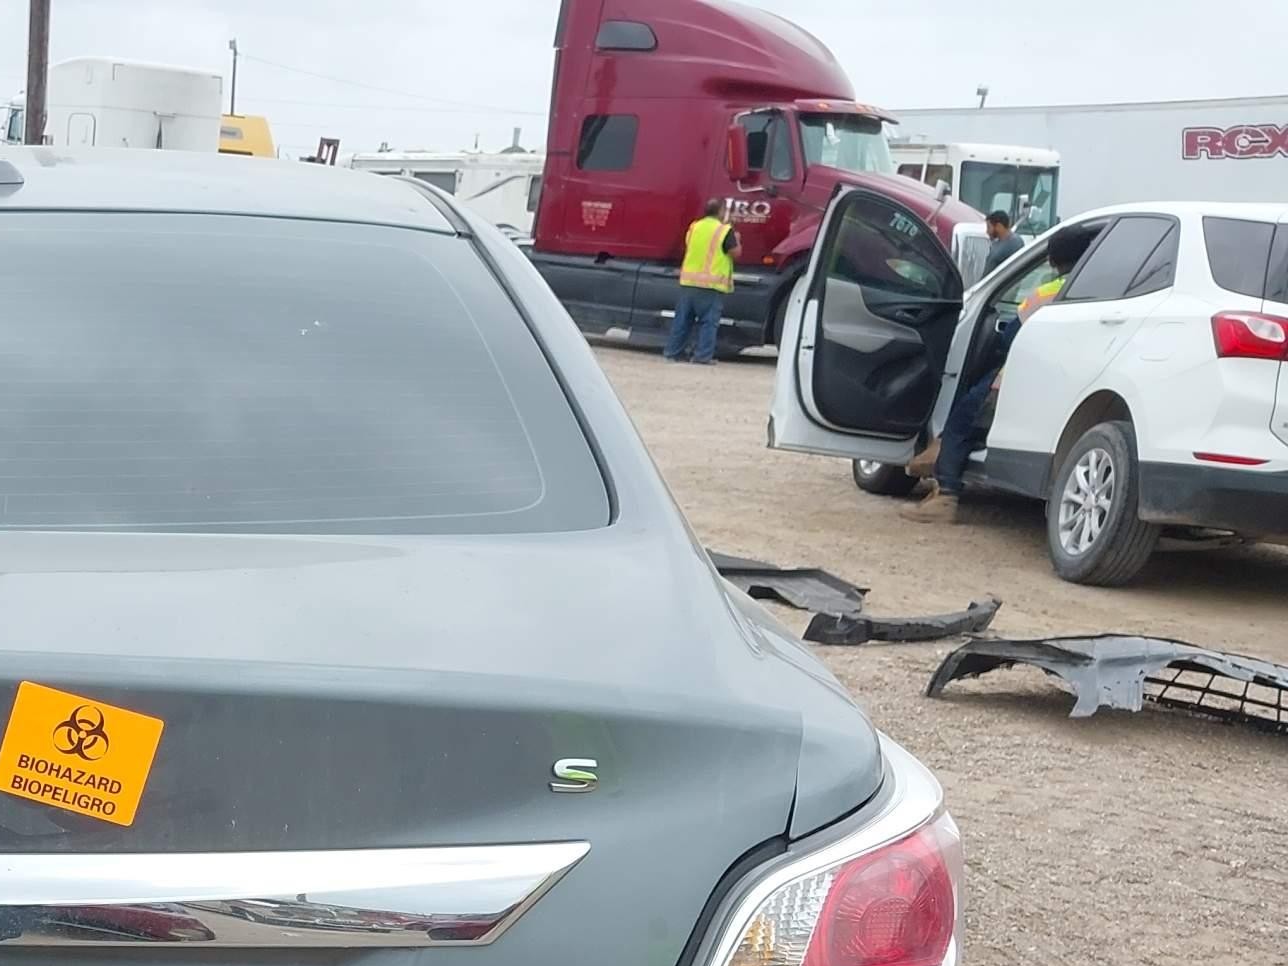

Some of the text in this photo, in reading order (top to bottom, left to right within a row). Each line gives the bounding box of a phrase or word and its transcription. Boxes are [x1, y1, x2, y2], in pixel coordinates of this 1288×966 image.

[1182, 124, 1288, 160] RCX
[17, 754, 122, 794] BIOHAZARD
[548, 757, 599, 793] S
[11, 775, 116, 816] BIOPELIGRO
